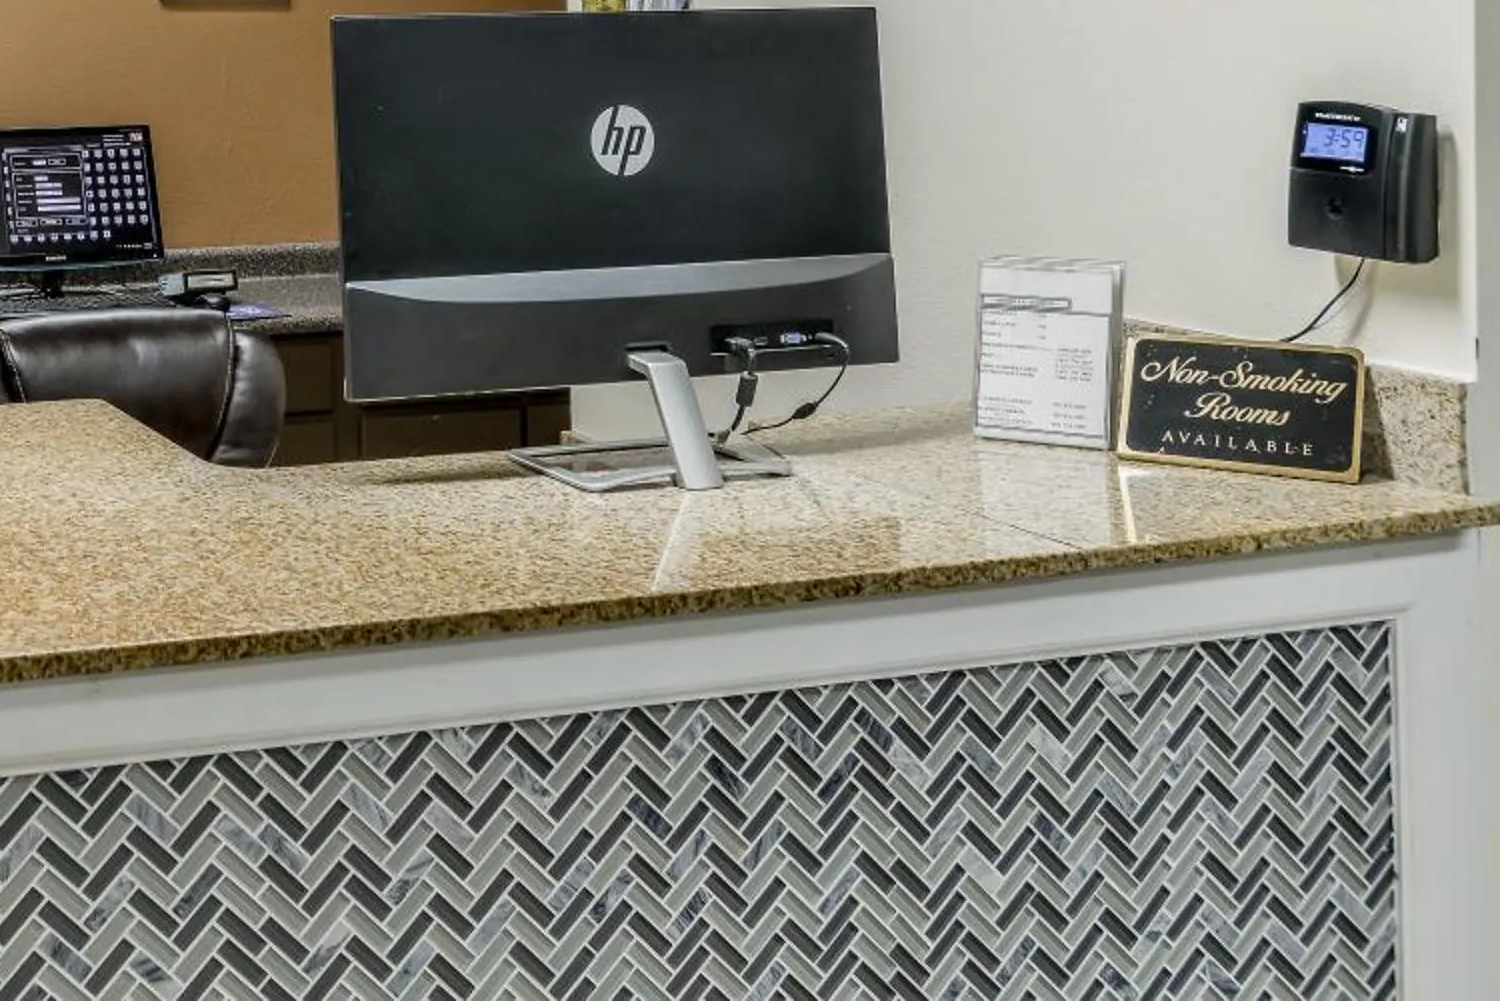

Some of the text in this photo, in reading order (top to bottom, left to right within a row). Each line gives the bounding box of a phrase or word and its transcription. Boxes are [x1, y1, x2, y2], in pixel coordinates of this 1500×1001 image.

[600, 104, 647, 176] hp
[1324, 128, 1365, 149] 3:59
[1141, 355, 1348, 403] Non-Smoking
[1183, 392, 1291, 427] Rooms
[1161, 430, 1314, 456] AVAILABLE
